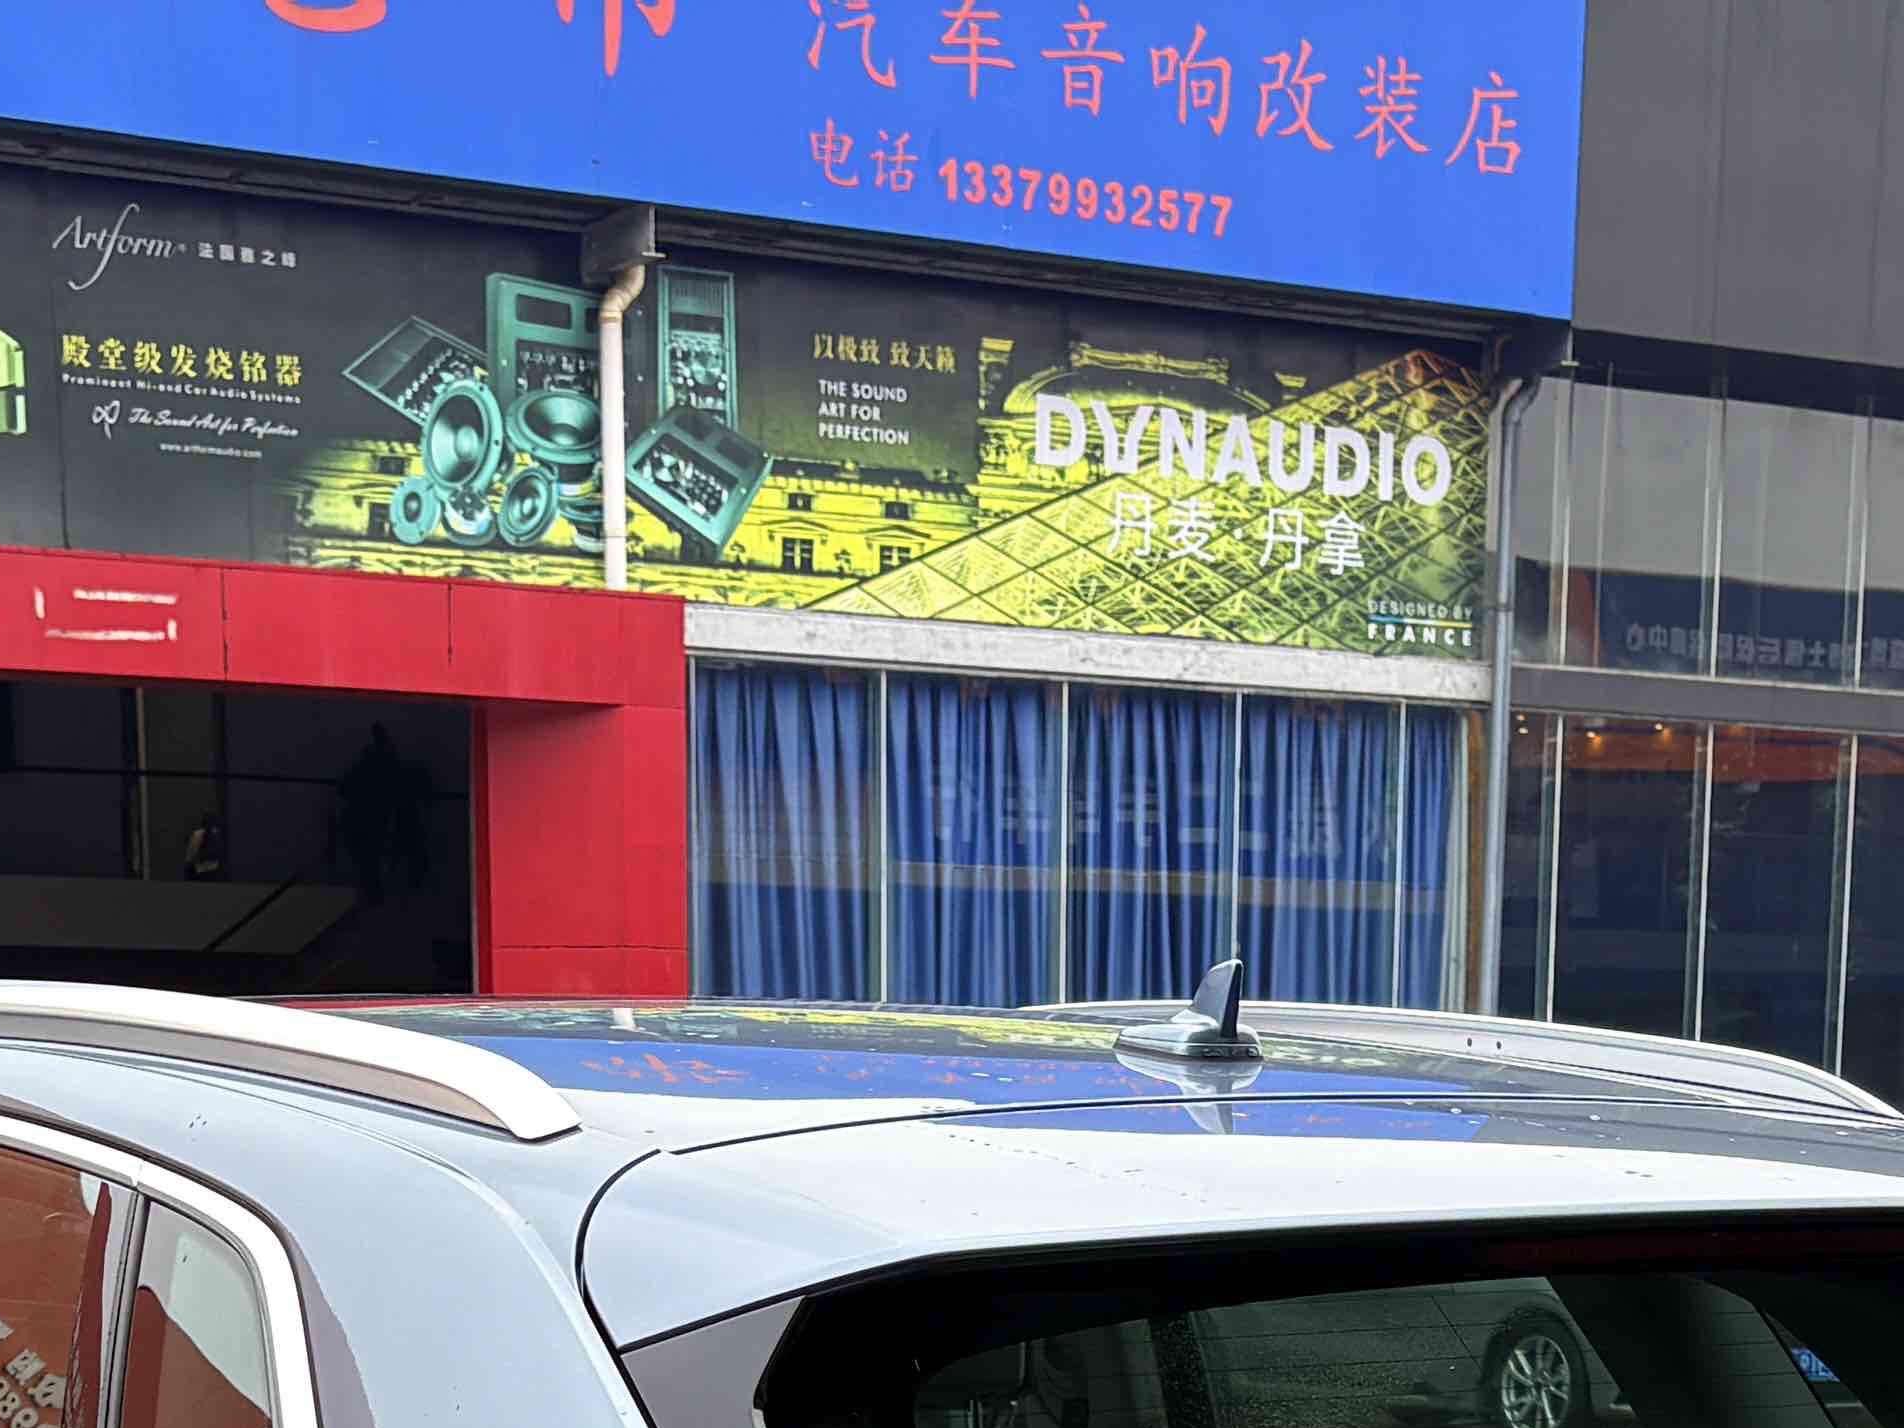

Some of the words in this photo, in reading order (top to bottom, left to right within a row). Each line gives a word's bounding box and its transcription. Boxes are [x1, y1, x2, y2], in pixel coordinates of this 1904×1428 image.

[807, 0, 1523, 175] 汽车音响改装店
[808, 116, 920, 194] 电话
[938, 158, 1234, 239] 13379932577
[818, 378, 848, 398] THE
[851, 381, 908, 402] SOUND
[818, 400, 847, 419] ART
[850, 403, 882, 422] FOR
[818, 421, 910, 446] PERFECTION
[1033, 391, 1453, 508] DYNAUDIO
[1367, 622, 1473, 647] FRANCE
